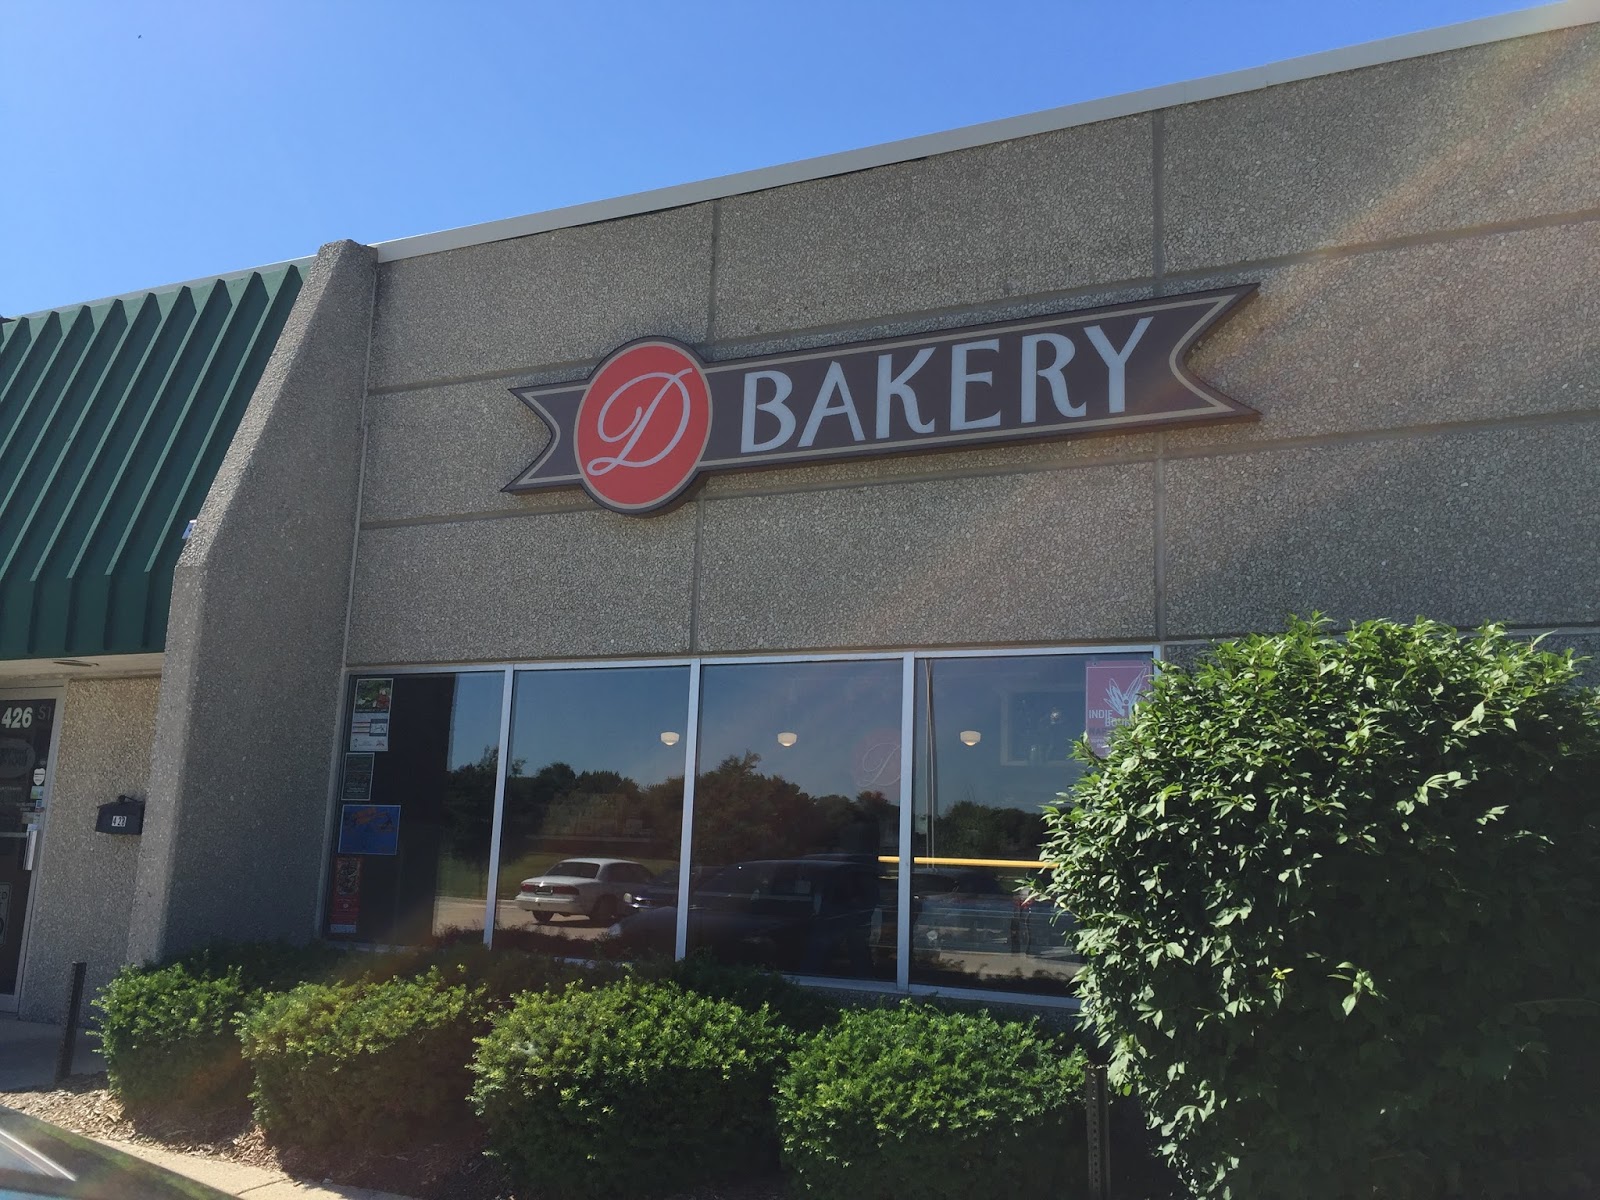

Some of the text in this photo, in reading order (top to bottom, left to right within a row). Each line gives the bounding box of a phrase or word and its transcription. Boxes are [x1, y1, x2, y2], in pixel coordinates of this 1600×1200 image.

[586, 317, 1154, 476] D BAKERY
[1, 706, 33, 729] 426
[1088, 709, 1113, 719] INDIE
